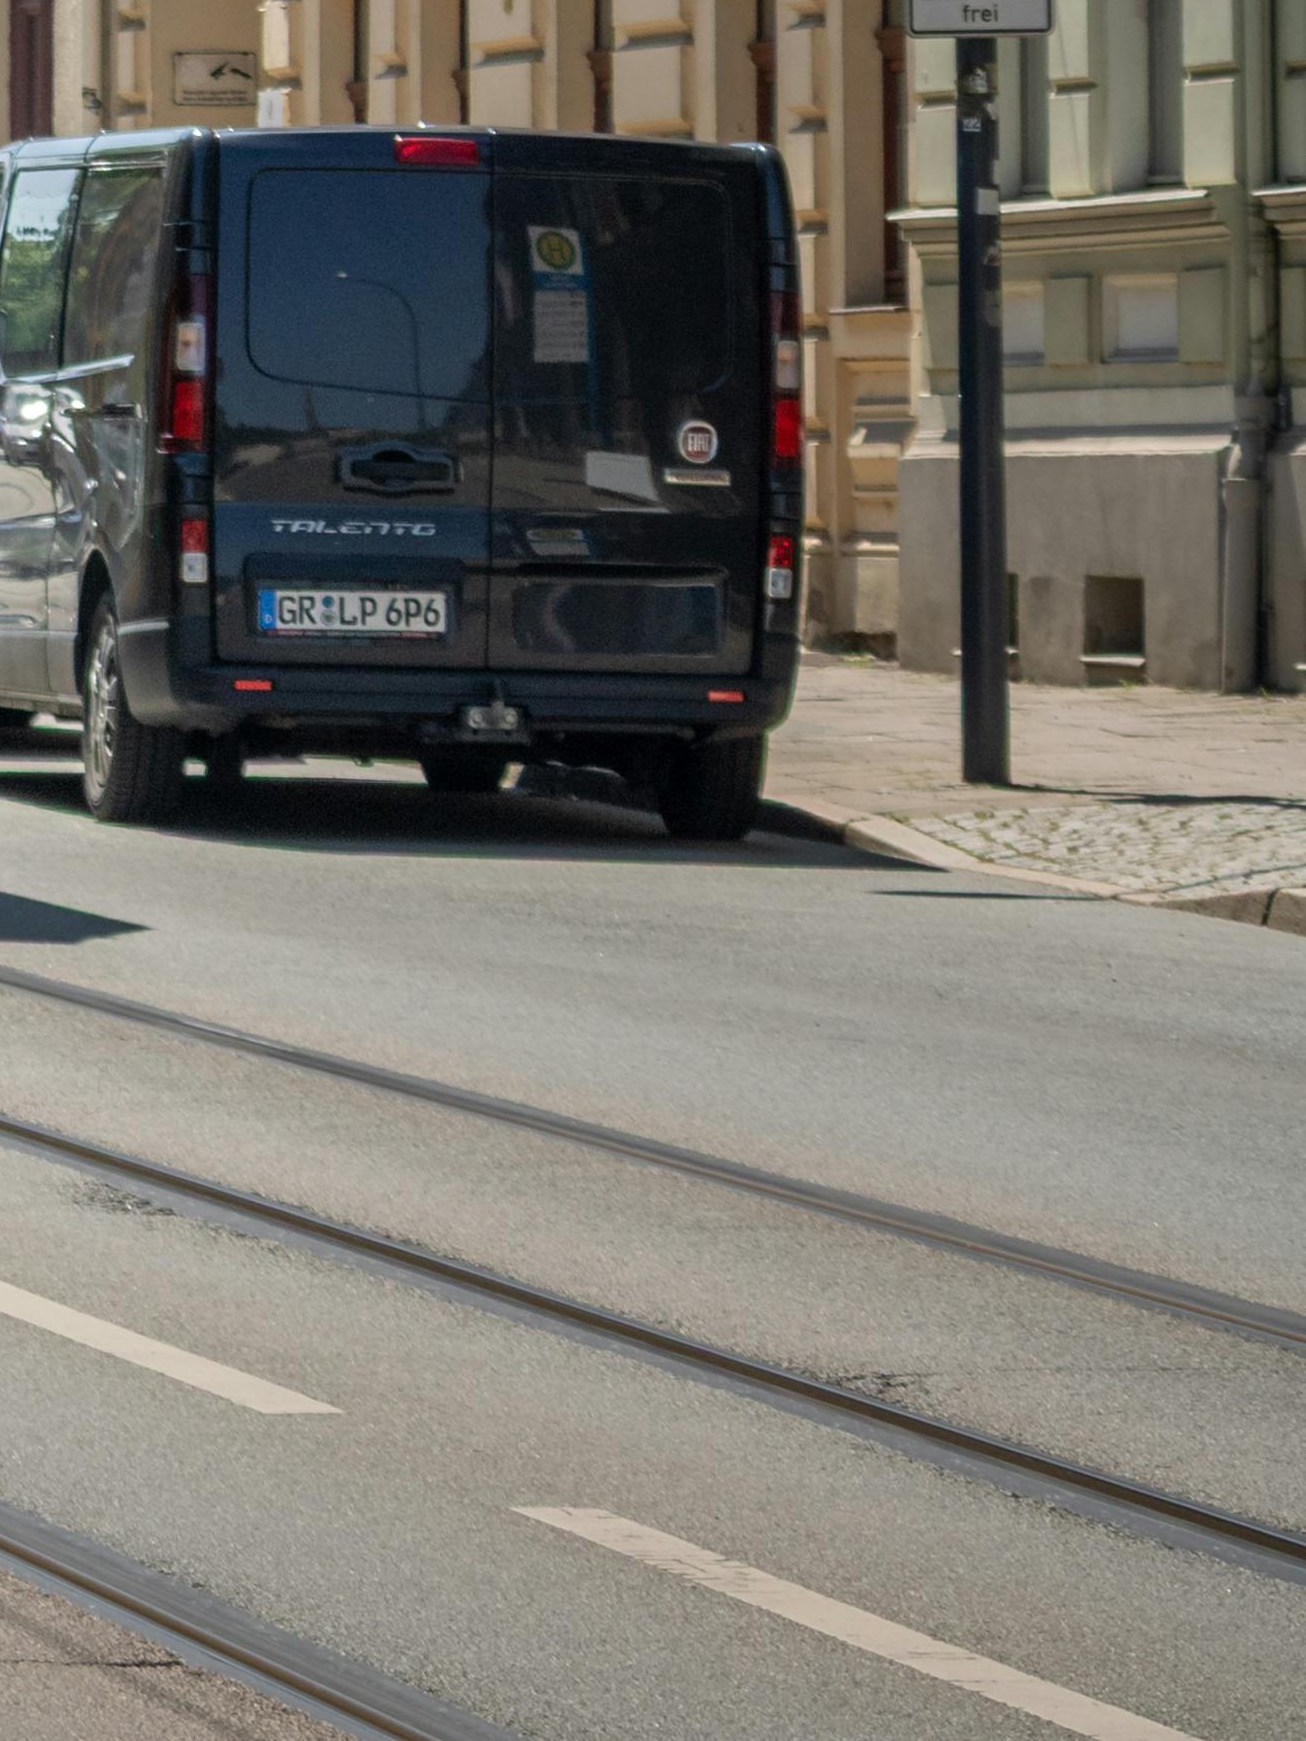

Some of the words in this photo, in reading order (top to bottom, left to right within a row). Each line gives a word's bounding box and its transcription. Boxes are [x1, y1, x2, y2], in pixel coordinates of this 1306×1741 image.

[962, 4, 999, 22] frei
[687, 433, 710, 453] FIAT
[271, 519, 436, 536] TALENTO
[279, 596, 317, 625] GR
[339, 597, 378, 626] LP
